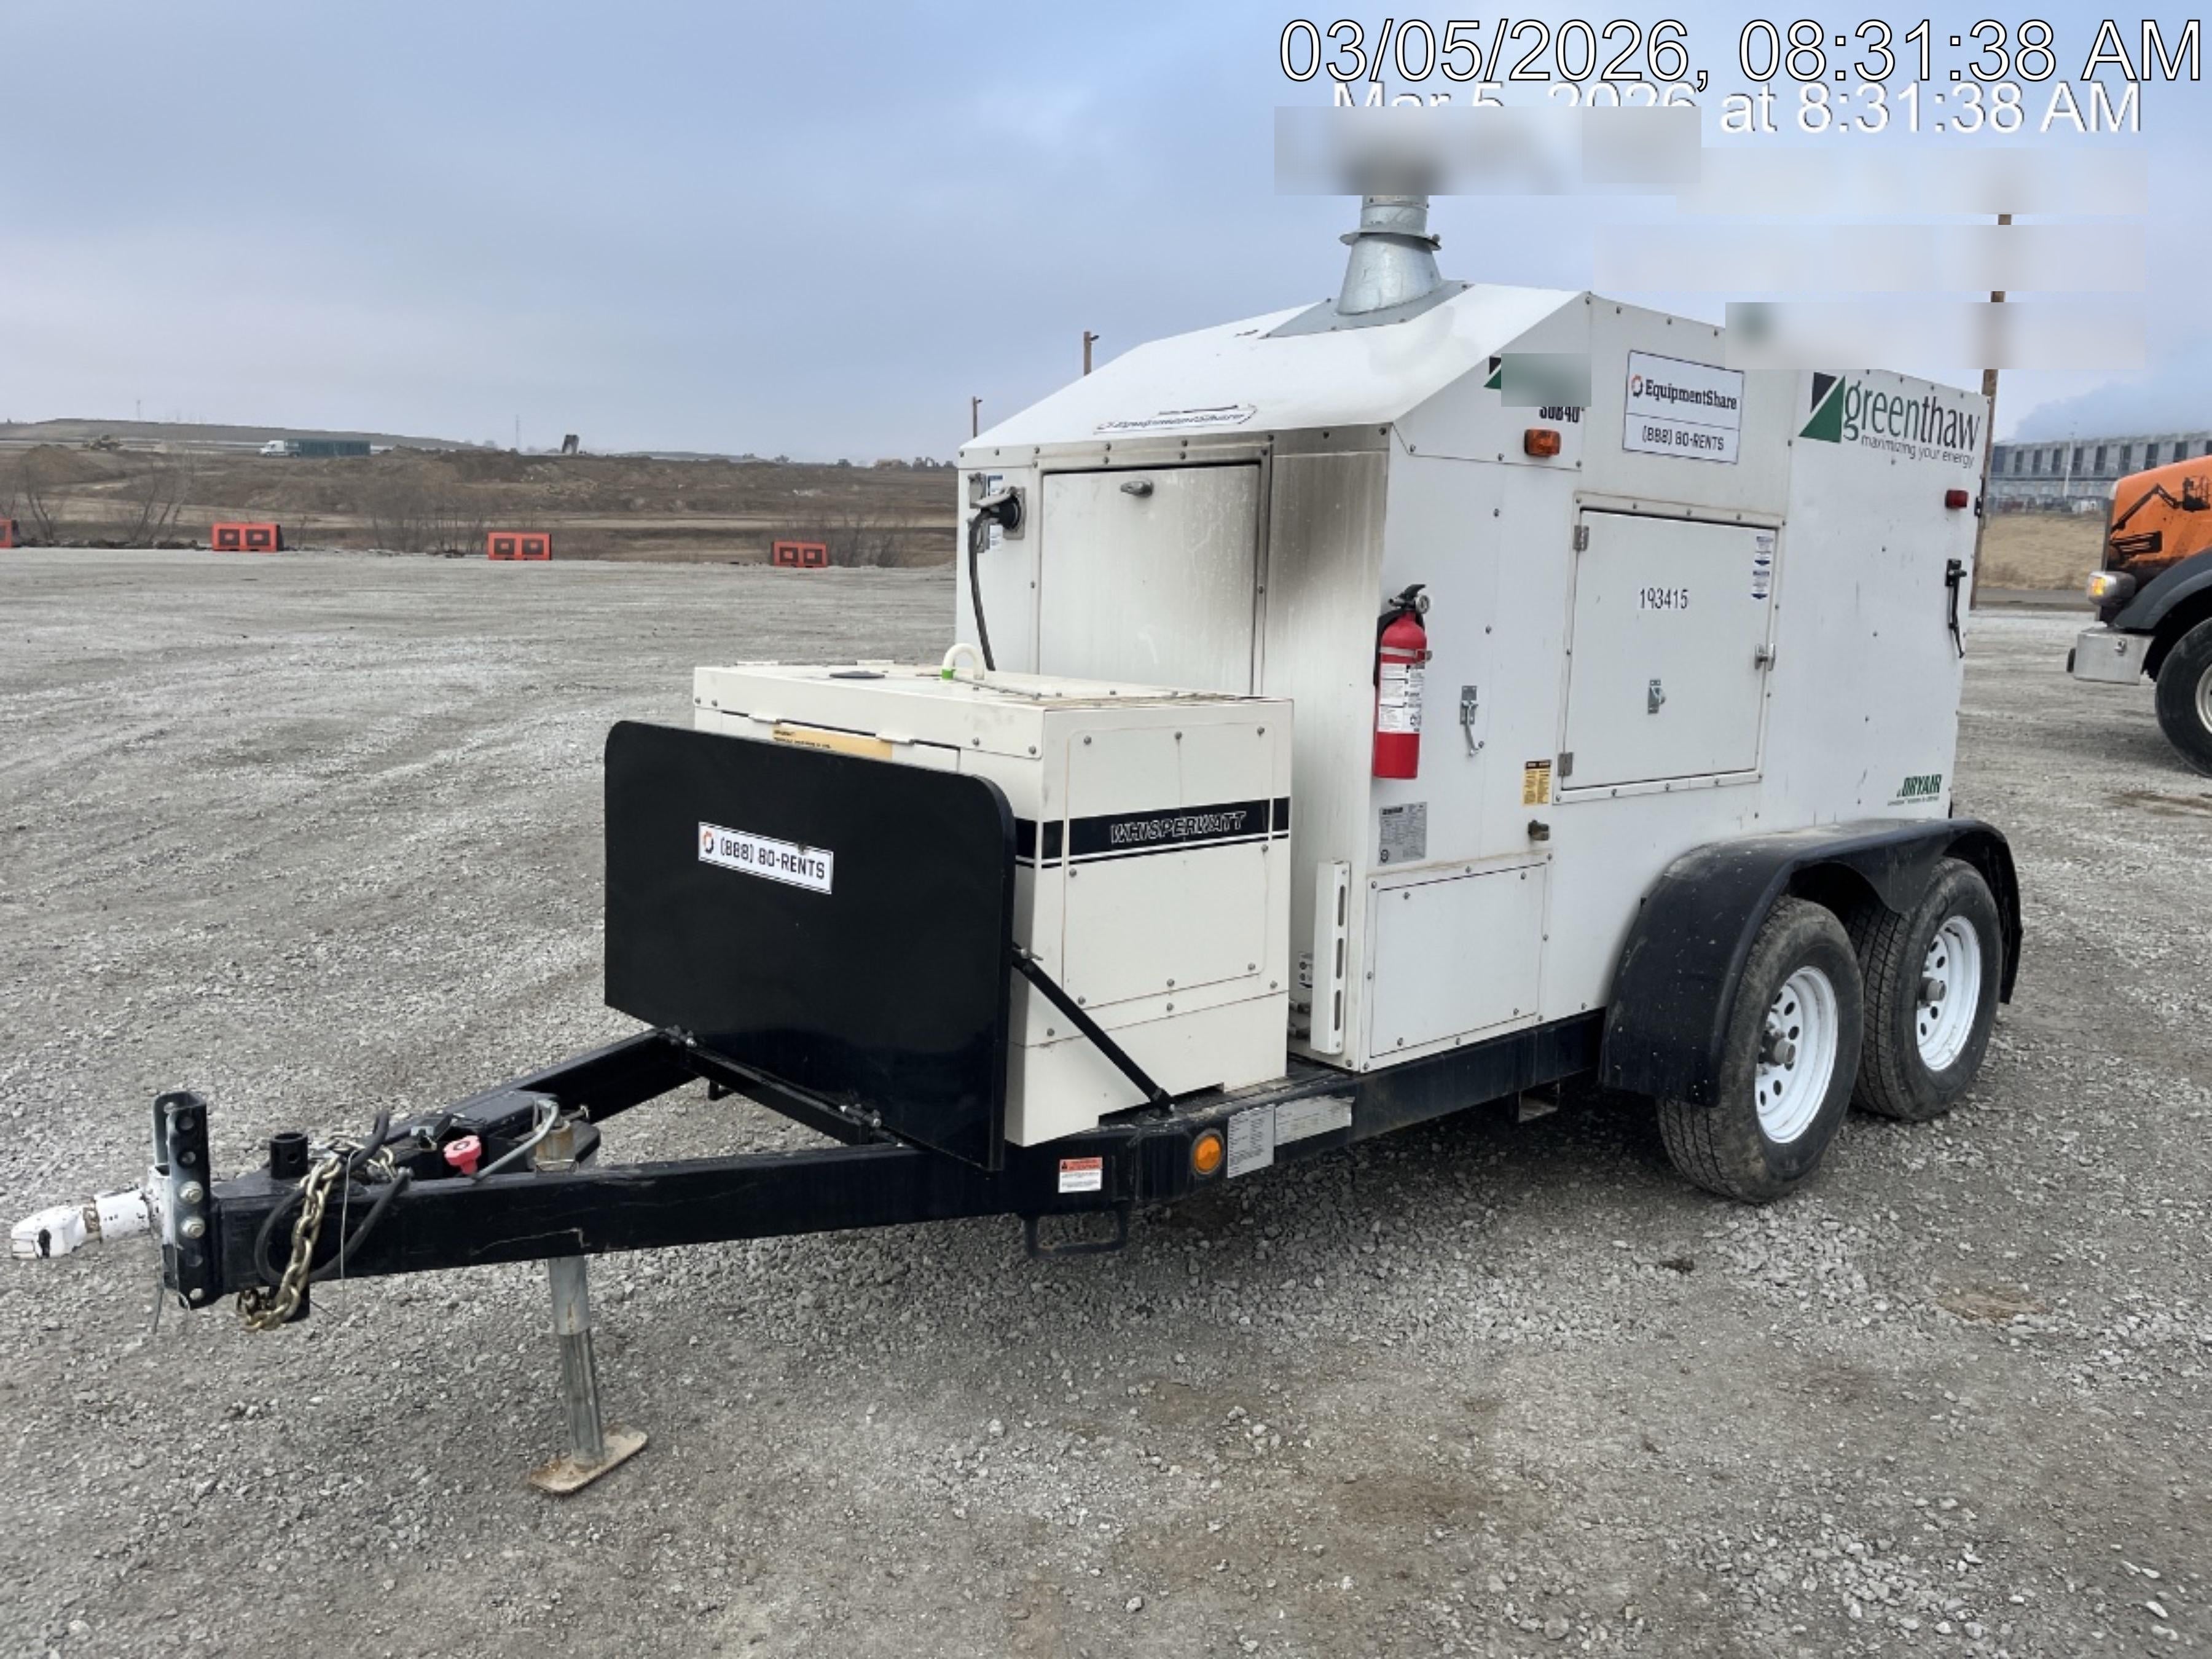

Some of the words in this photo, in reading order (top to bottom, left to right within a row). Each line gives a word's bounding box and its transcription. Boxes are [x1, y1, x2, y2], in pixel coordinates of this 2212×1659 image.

[1645, 378, 1738, 410] EquipmentShare
[1843, 380, 1980, 451] greenthaw
[1642, 425, 1673, 445] (888)
[1861, 434, 1916, 460] maximizing
[1918, 445, 1940, 462] your
[1942, 450, 1975, 469] energy
[1639, 587, 1688, 610] 193415
[1110, 810, 1247, 845] WHISPERWATT
[720, 836, 755, 864] (888)
[758, 847, 825, 880] 80-RENTS
